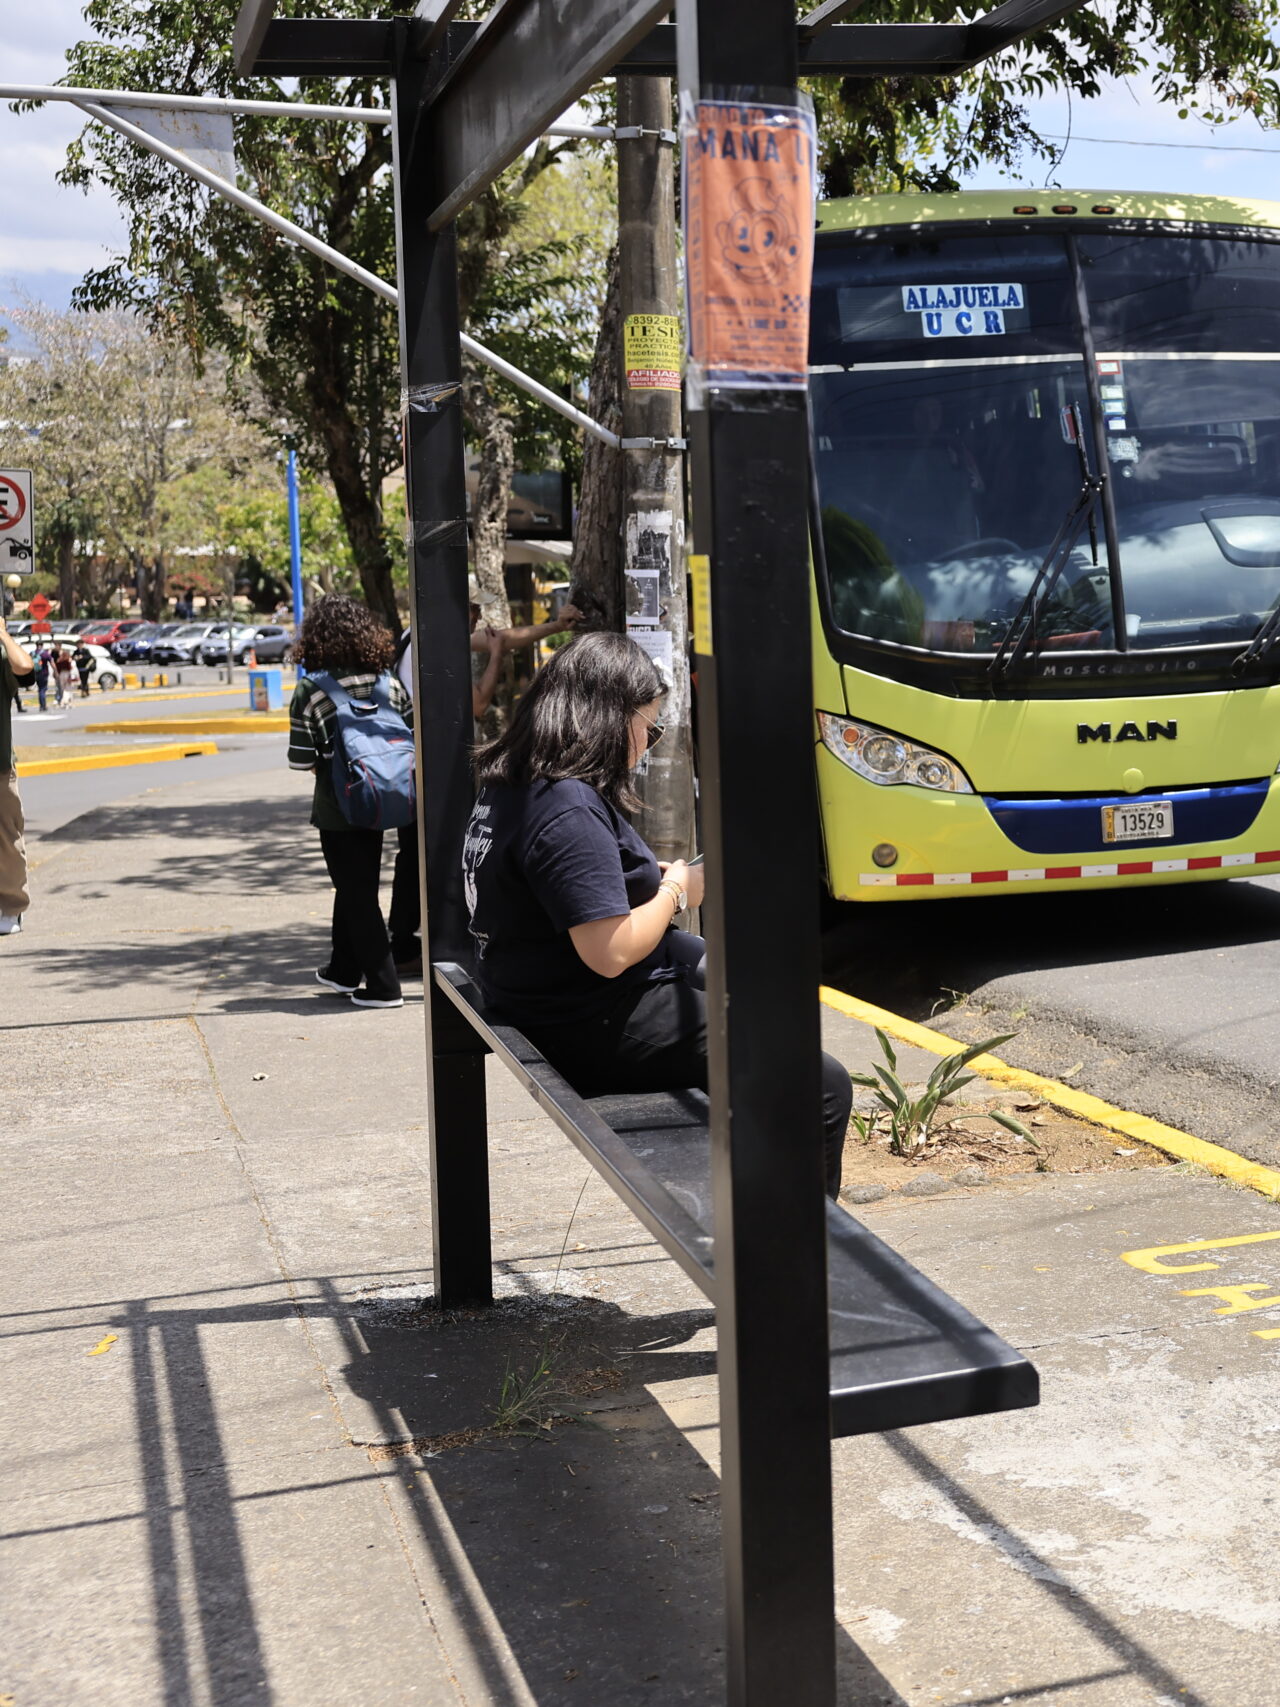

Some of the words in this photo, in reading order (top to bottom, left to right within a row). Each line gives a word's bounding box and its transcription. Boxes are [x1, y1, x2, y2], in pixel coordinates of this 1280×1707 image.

[906, 285, 1020, 310] ALAJUELA
[1077, 719, 1177, 744] MAN
[1121, 812, 1164, 832] 13529
